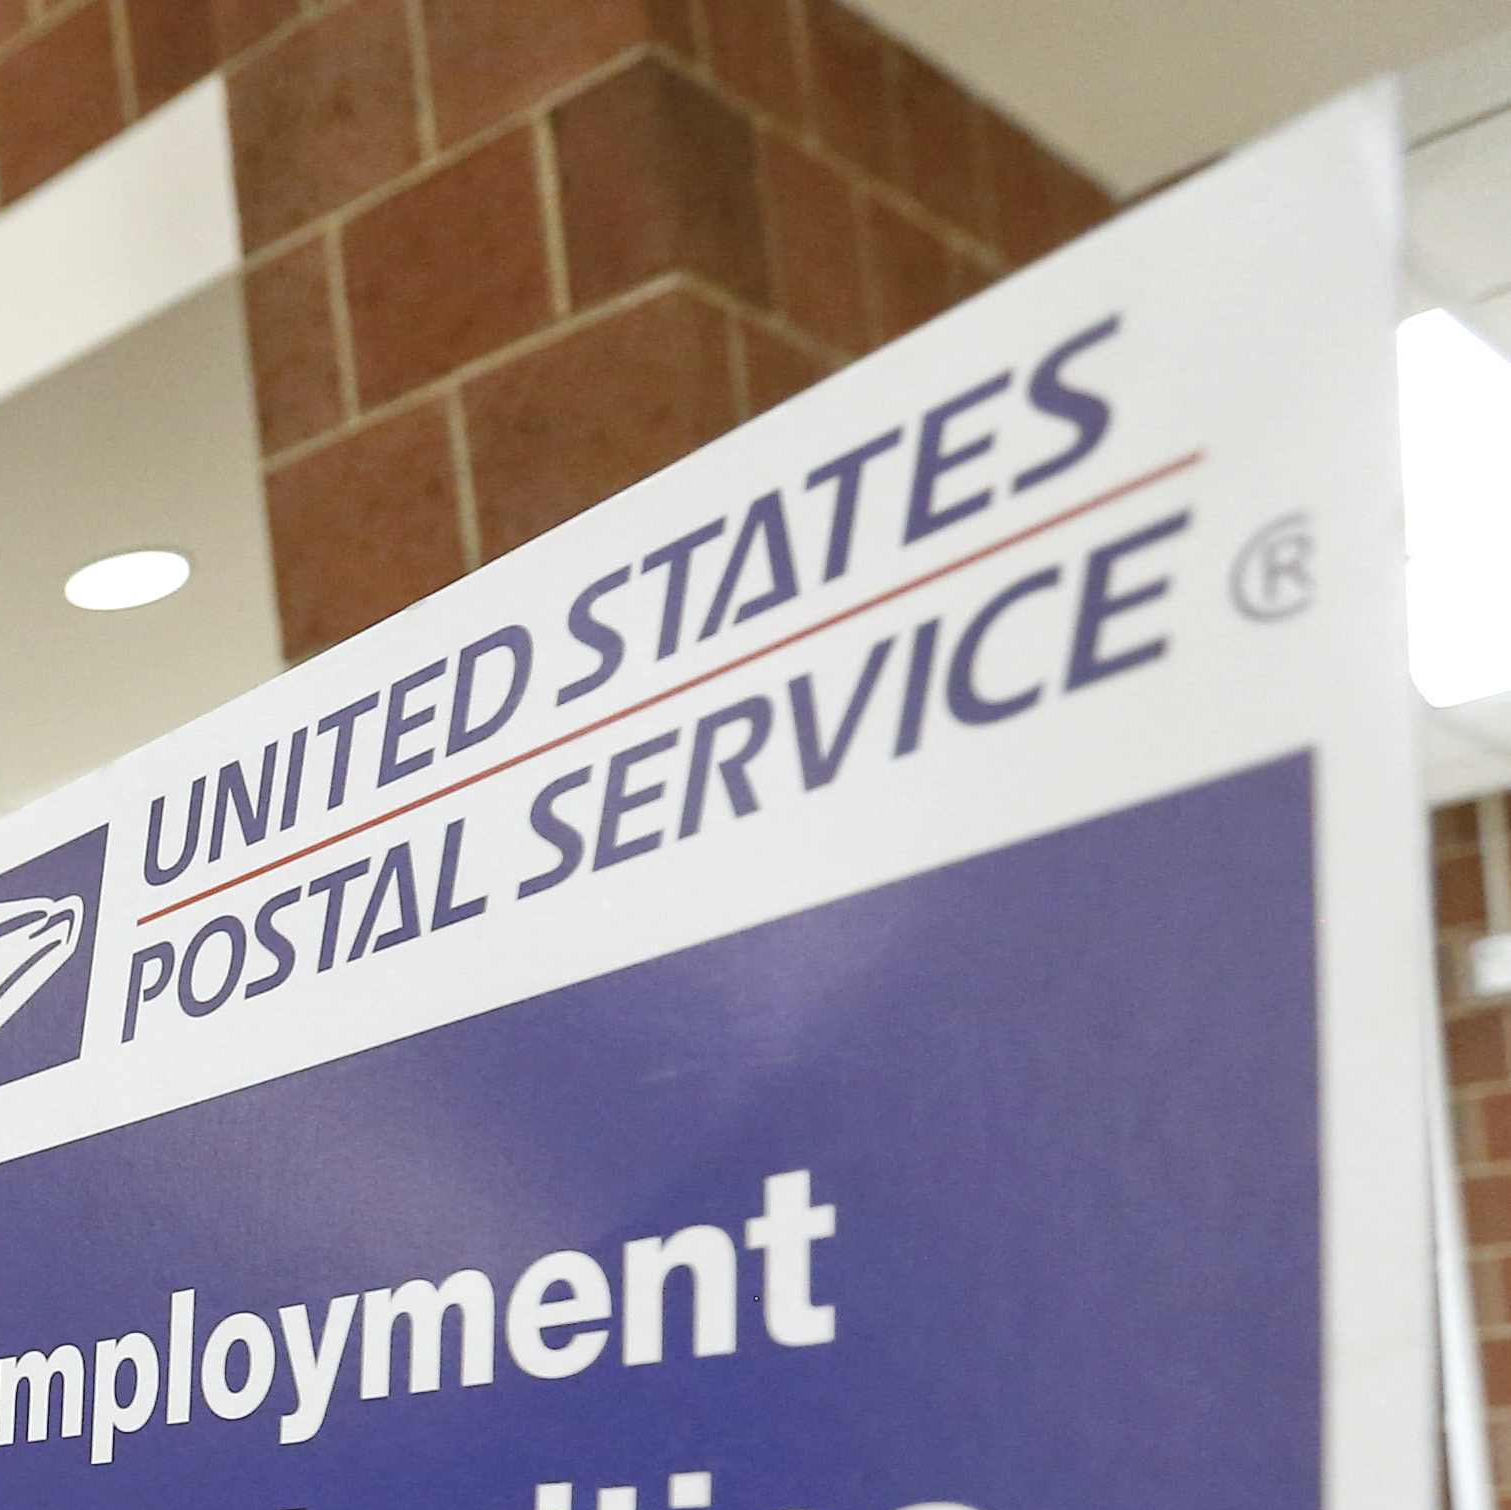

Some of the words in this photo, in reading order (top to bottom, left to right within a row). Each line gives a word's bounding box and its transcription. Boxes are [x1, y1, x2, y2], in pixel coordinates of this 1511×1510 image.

[121, 818, 485, 1044] POSTAL
[517, 515, 1187, 900] SERVICE
[144, 626, 533, 888] UNITED
[556, 321, 1117, 707] STATES
